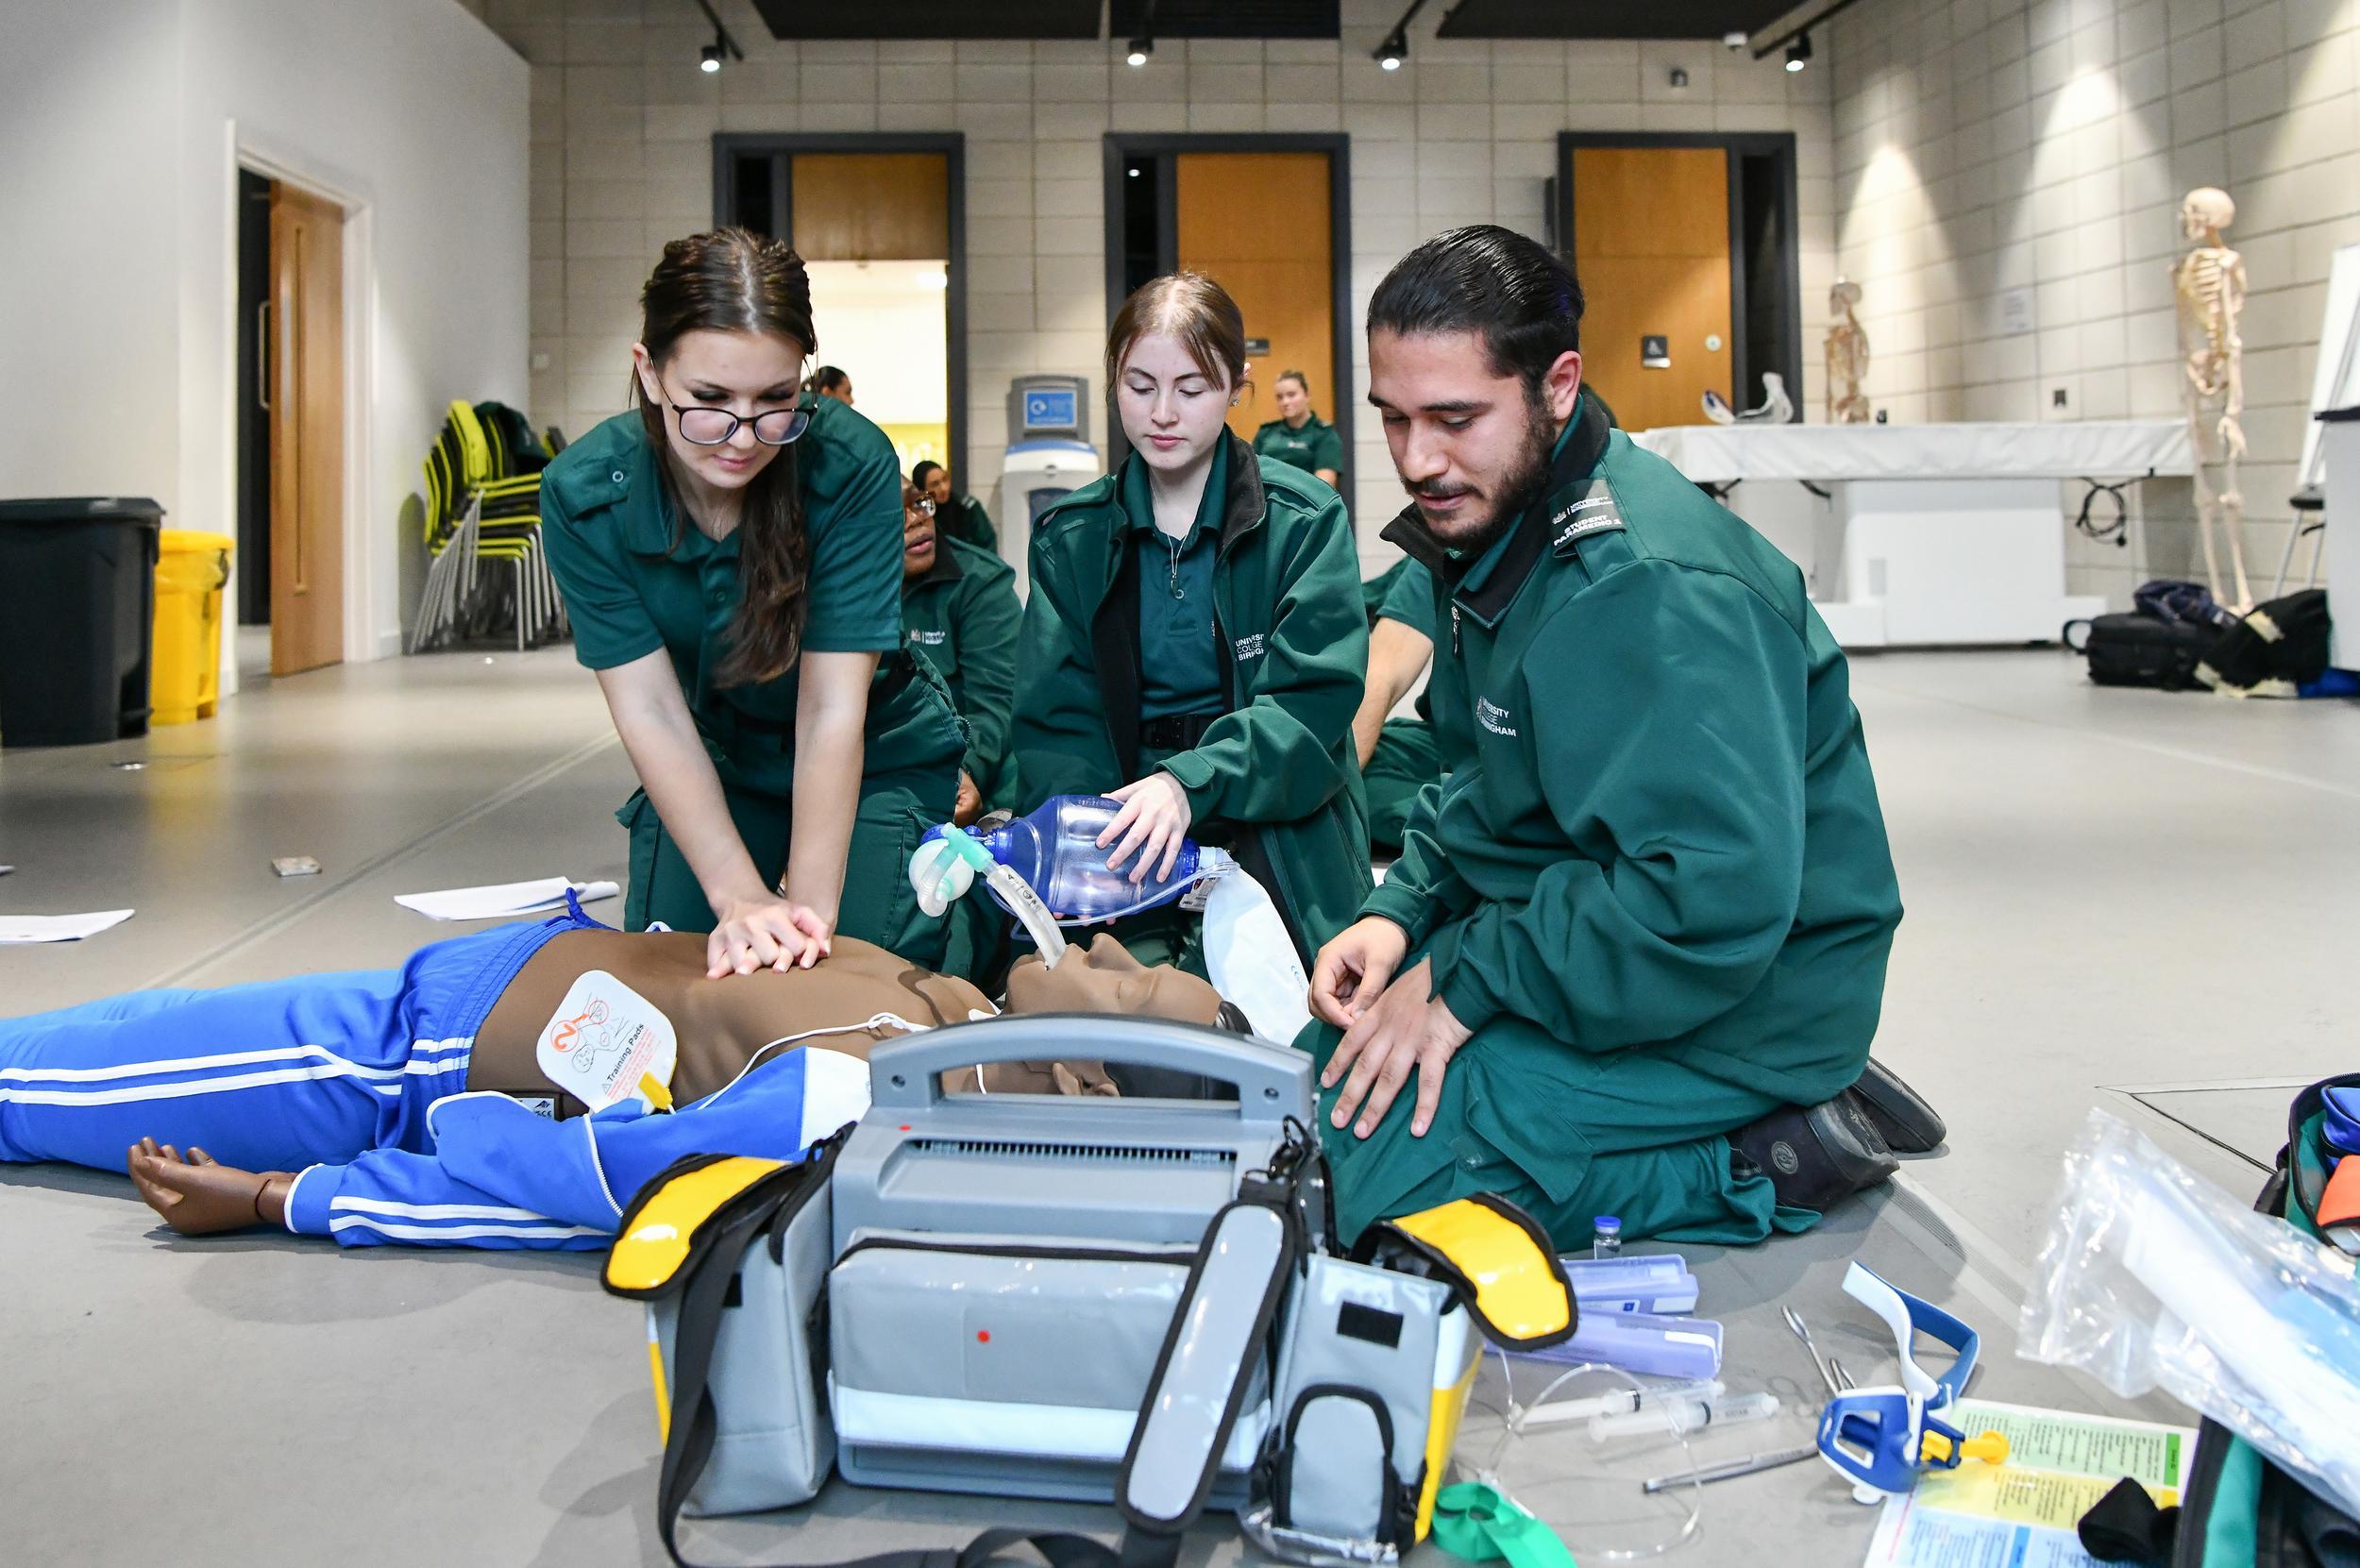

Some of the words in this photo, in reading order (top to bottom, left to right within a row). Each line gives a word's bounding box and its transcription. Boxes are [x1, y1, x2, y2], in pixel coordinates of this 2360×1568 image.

[1553, 519, 1613, 547] PARAMEDIC
[1563, 514, 1608, 534] STUDENT
[1235, 633, 1265, 648] UNIVRSIT
[1237, 640, 1263, 654] COLGE
[553, 1022, 577, 1051] 2
[606, 1046, 632, 1083] Training
[628, 1022, 645, 1046] Pads
